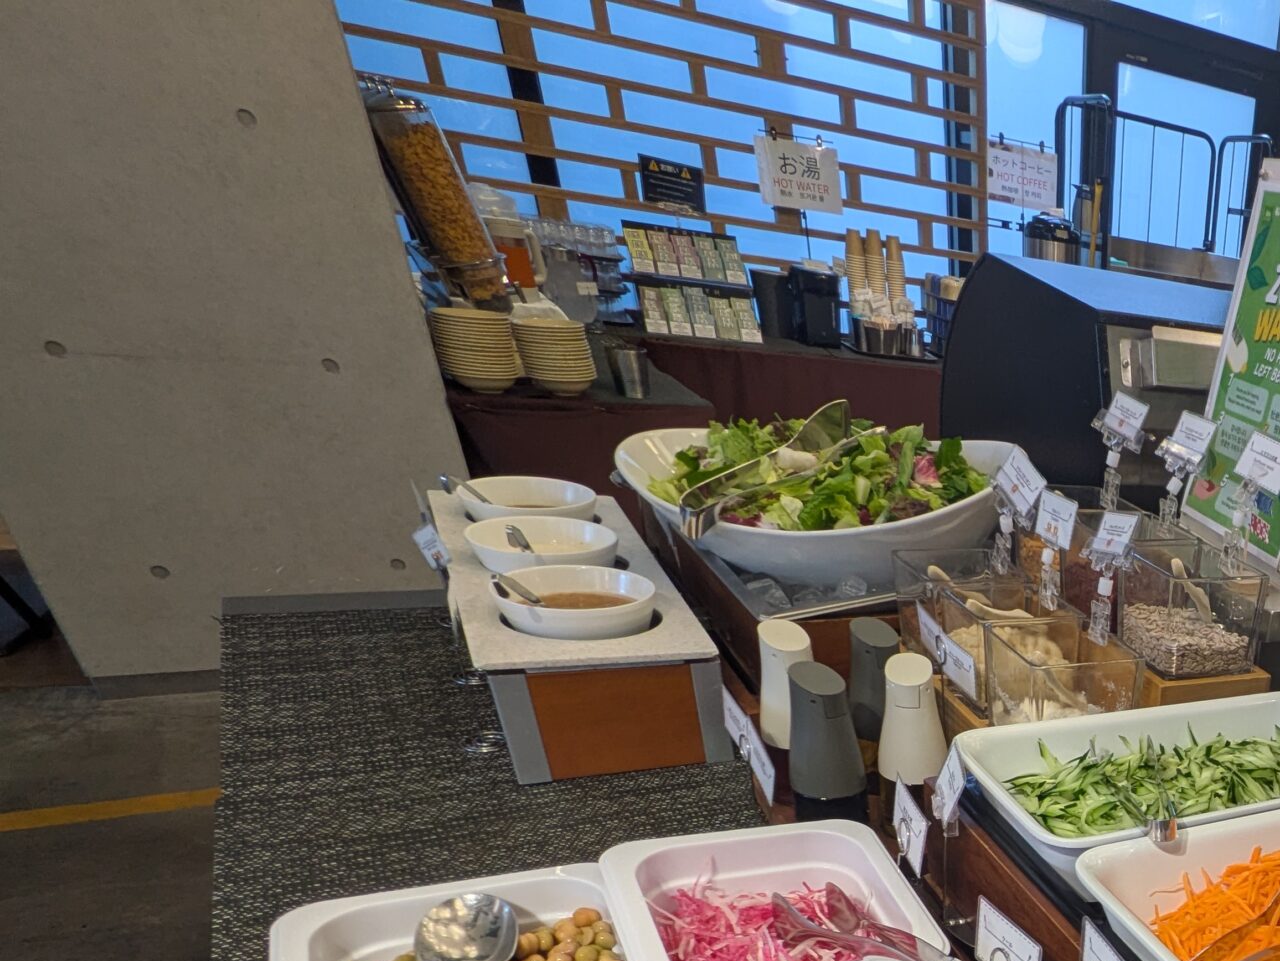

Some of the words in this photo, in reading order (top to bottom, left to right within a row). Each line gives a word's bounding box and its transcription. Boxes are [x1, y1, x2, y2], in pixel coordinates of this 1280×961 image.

[778, 152, 821, 181] お湯
[992, 154, 1052, 175] ホットコーヒー
[773, 177, 794, 190] HOT
[796, 181, 830, 195] WATER
[996, 171, 1015, 183] HOT
[1016, 175, 1048, 191] COFFEE
[1264, 347, 1277, 362] NO
[1253, 363, 1272, 379] LEFT
